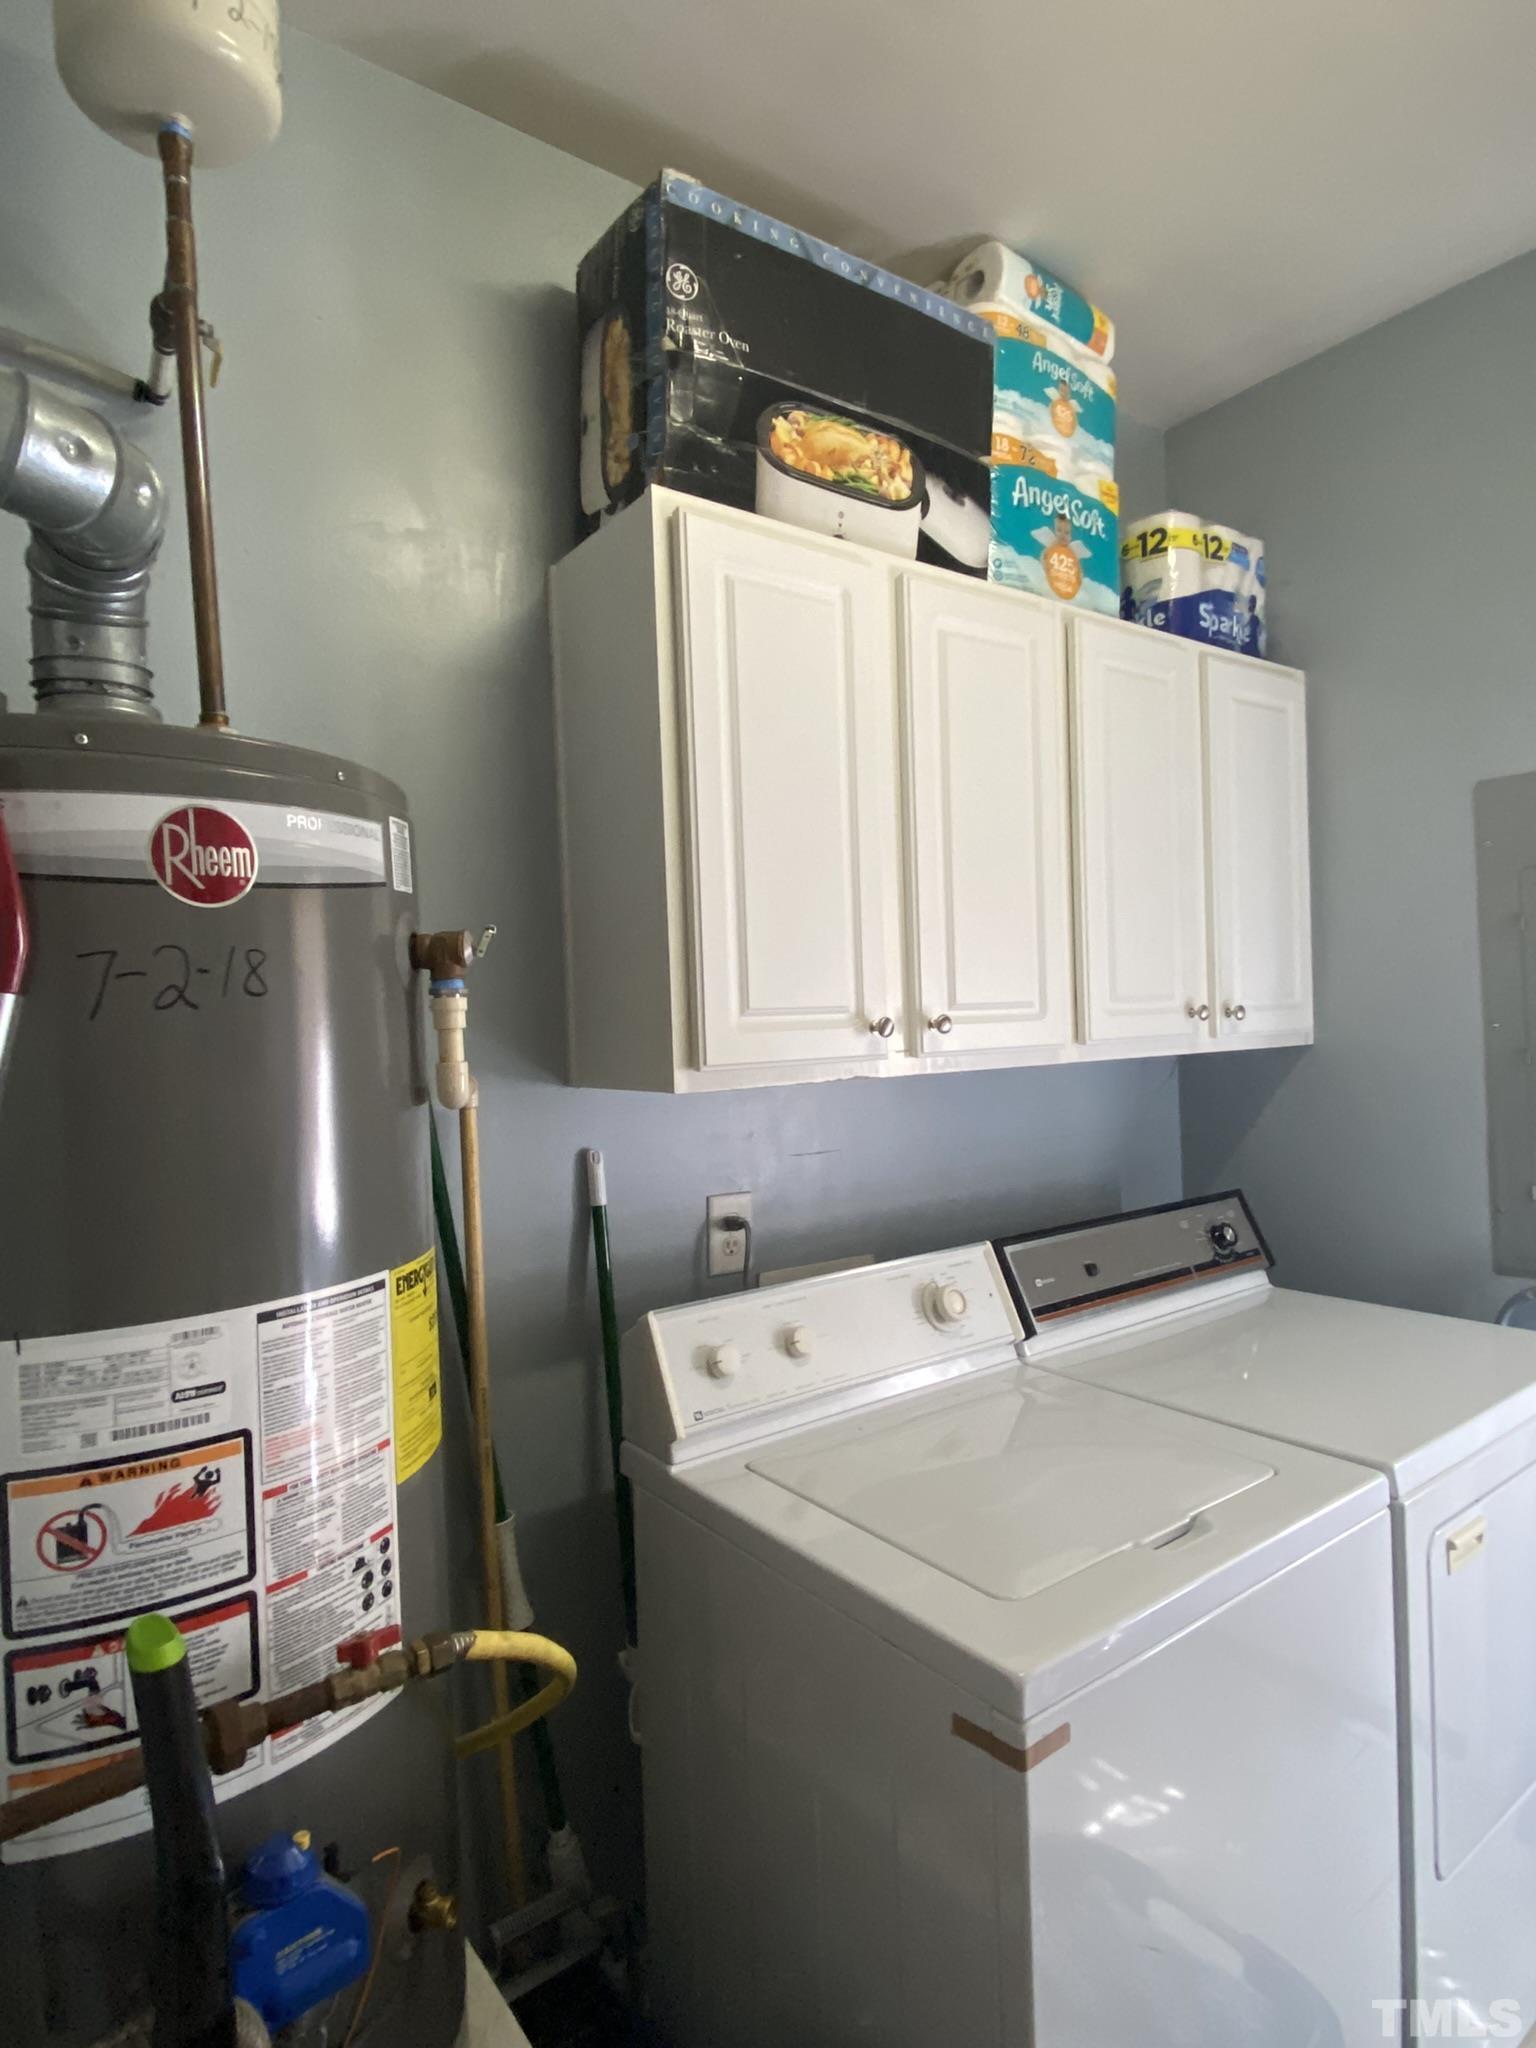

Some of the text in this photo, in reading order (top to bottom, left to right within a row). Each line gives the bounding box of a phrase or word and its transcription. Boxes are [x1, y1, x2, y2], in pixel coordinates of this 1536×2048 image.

[664, 182, 800, 249] COOKING
[665, 318, 750, 353] Roaster Oven
[1031, 351, 1071, 382] Angel
[1011, 475, 1107, 539] Angel Soft
[1136, 527, 1169, 559] 12
[1202, 533, 1224, 561] 12
[1049, 552, 1076, 576] 425
[161, 807, 253, 890] Rheem
[75, 945, 269, 1022] 7-2-18
[97, 1456, 181, 1483] WARNING
